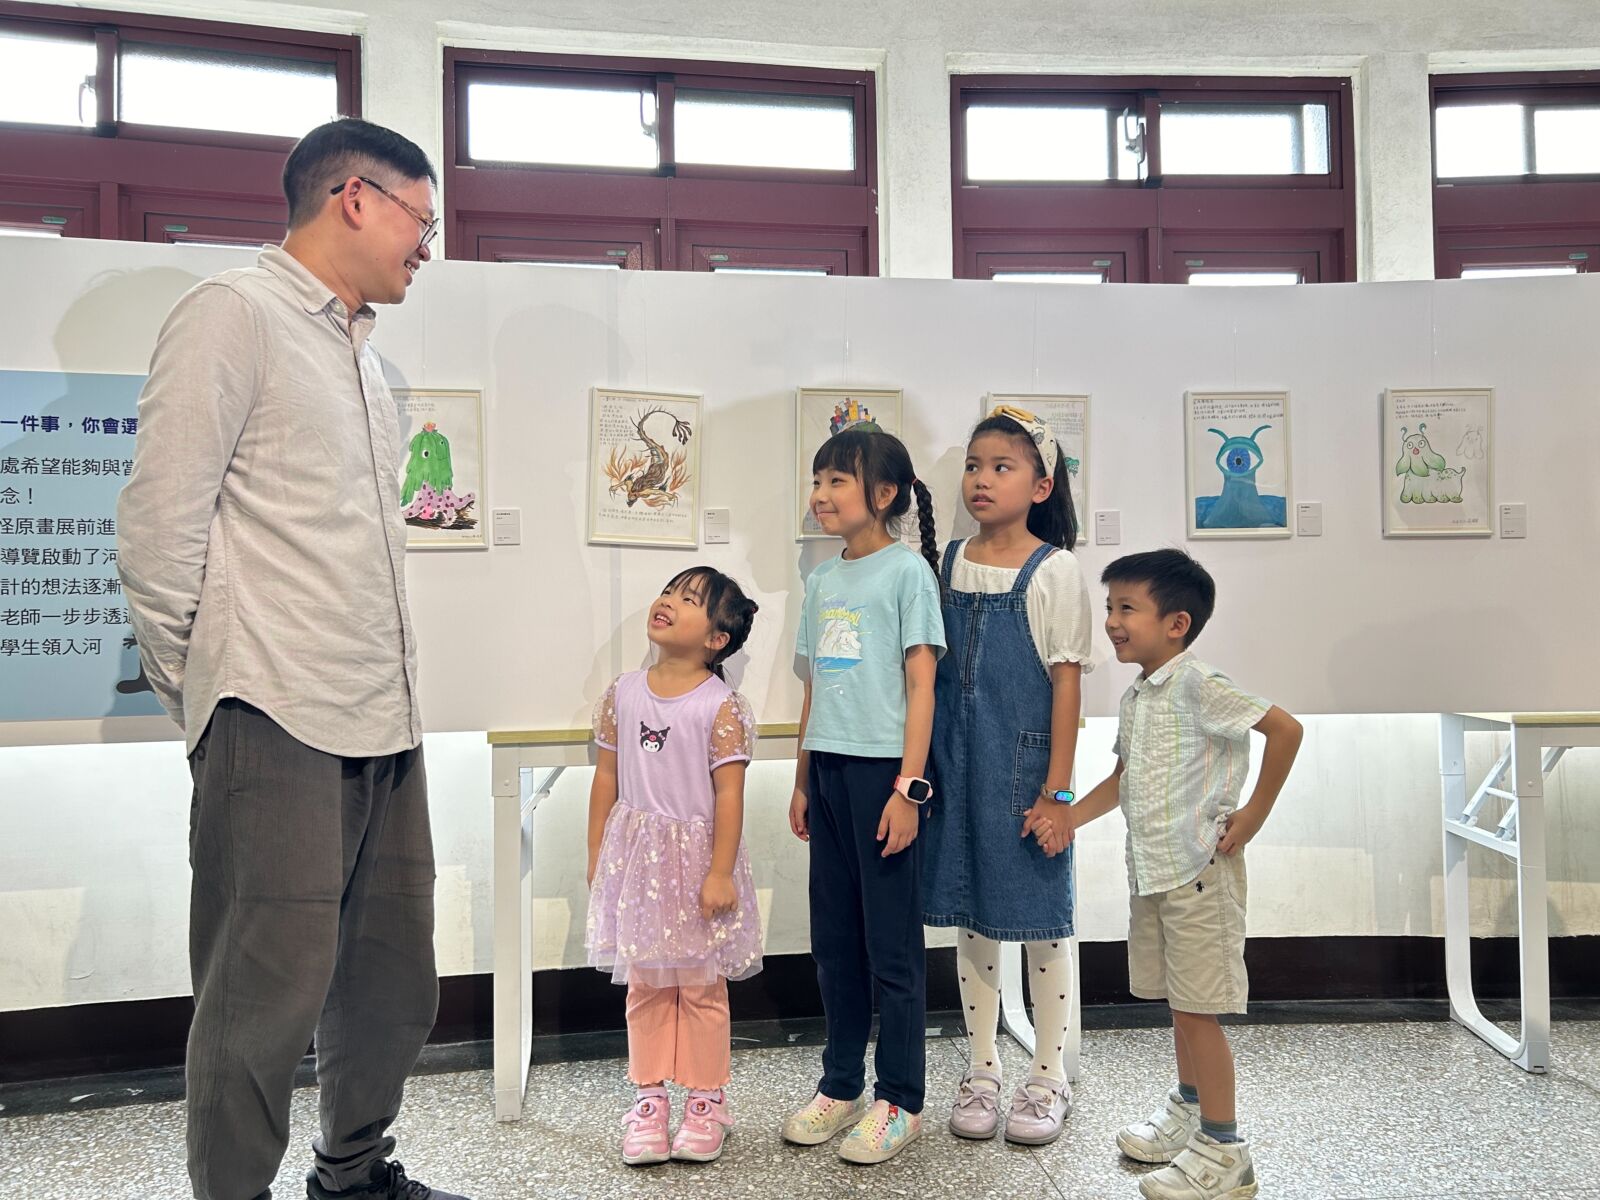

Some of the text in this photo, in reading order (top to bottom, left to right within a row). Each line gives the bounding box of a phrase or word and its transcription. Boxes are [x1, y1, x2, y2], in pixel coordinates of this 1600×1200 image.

[0, 487, 32, 504] 念！
[0, 578, 121, 595] 計的想法逐漸
[0, 638, 102, 656] 學生領入河
